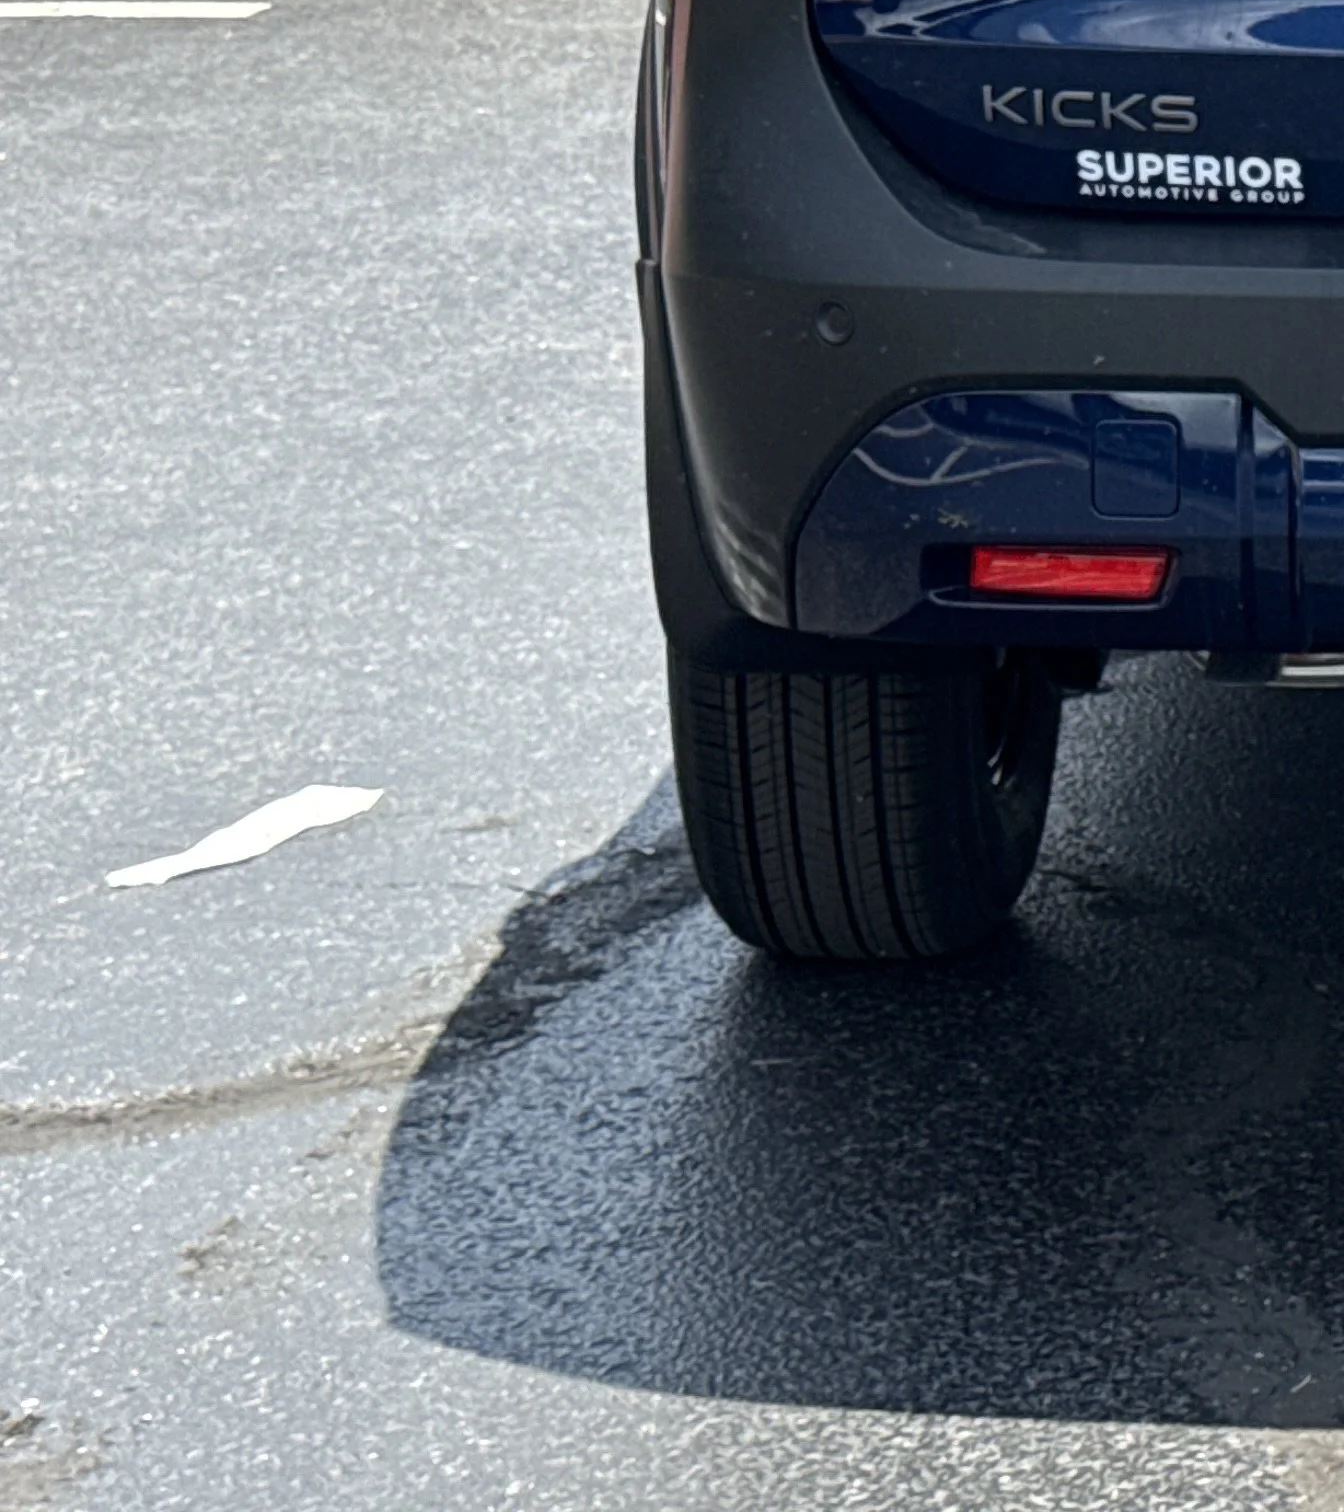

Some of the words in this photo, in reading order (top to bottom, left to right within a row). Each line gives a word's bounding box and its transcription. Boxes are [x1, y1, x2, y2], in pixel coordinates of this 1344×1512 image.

[982, 84, 1199, 134] KICKS
[1075, 149, 1304, 189] SUPERIOR
[1079, 183, 1219, 202] AUTOMOTIVE
[1230, 188, 1306, 204] GROUP
